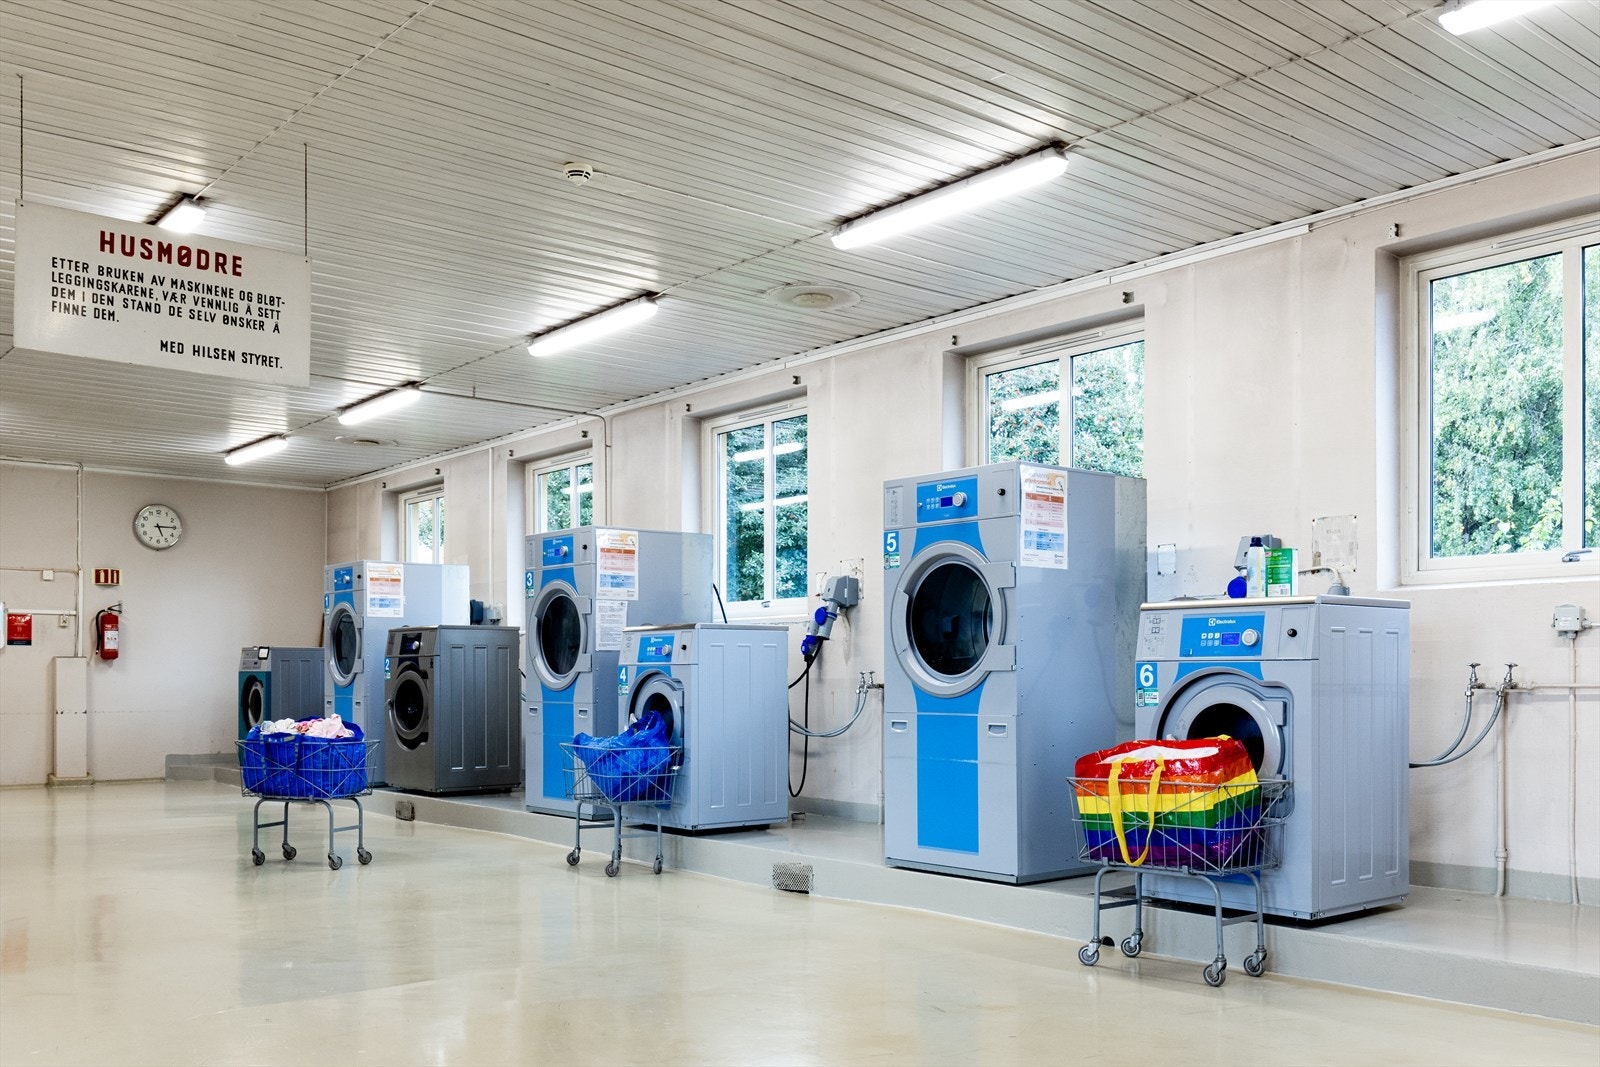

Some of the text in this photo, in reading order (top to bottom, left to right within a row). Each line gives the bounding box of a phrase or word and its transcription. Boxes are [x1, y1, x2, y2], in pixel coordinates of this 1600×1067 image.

[99, 229, 243, 278] HUSMØDRE
[51, 256, 286, 308] ETTER BRUKEN AV MASKINENE OG BLØT-
[51, 285, 281, 334] DEM I DEN STAND DE SELV ØNSKER Å
[51, 299, 120, 323] FINNE DEM.
[161, 289, 187, 305] VÆR
[192, 294, 239, 314] VENNLIG
[245, 302, 253, 316] Å
[257, 306, 282, 321] SETT
[159, 339, 284, 370] MED HILSEN STYRET.
[886, 532, 897, 552] 5
[526, 572, 533, 587] 3
[385, 658, 390, 671] 2
[619, 667, 627, 682] 4
[1139, 664, 1154, 687] 6
